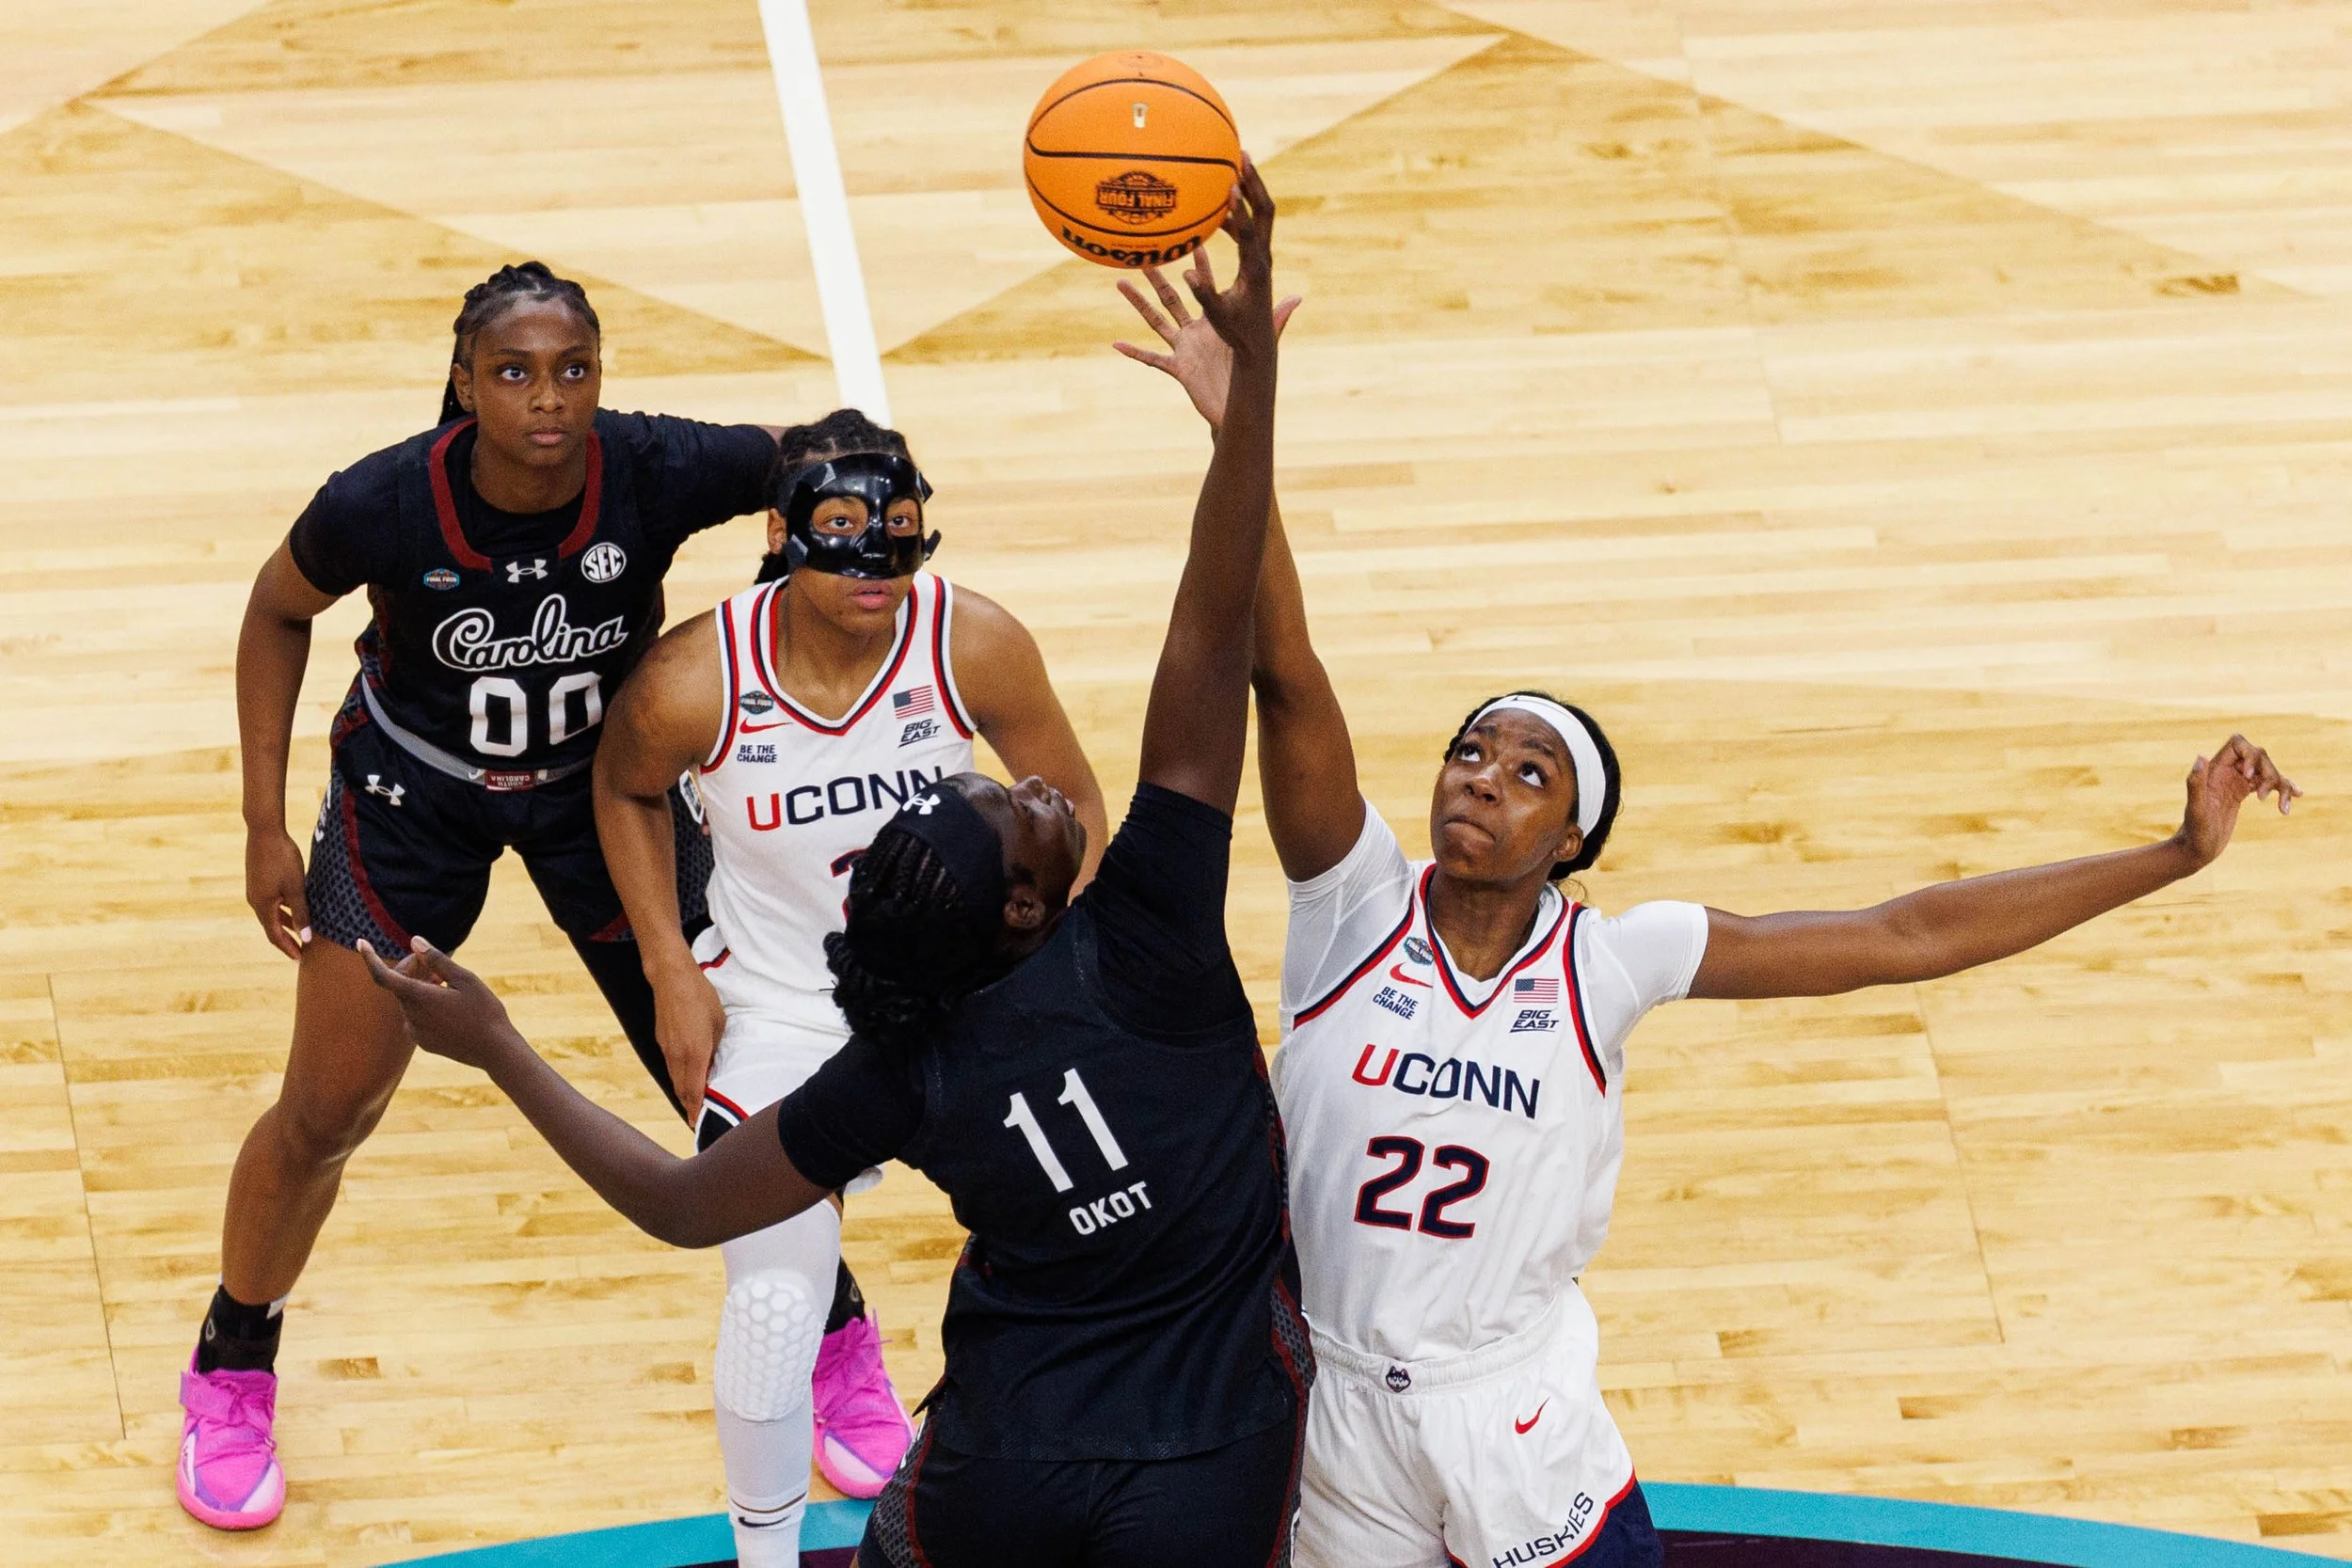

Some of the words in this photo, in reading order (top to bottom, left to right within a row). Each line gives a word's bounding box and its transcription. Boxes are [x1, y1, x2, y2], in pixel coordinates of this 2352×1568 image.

[584, 546, 624, 581] SEC
[432, 594, 628, 672] Carolina
[469, 671, 603, 757] 00
[904, 719, 932, 733] BIG
[739, 744, 753, 753] BE
[756, 744, 775, 753] THE
[901, 724, 941, 742] EAST
[737, 752, 778, 763] CHANGE
[1373, 993, 1416, 1021] CHANGE
[1381, 986, 1398, 1000] BE
[1397, 993, 1419, 1010] THE
[1513, 1019, 1559, 1029] EAST
[1518, 1009, 1550, 1020] BIG
[1351, 1043, 1541, 1120] UCONN
[1003, 1068, 1129, 1193] 11
[1354, 1135, 1490, 1240] 22
[1069, 1180, 1152, 1236] OKOT
[1492, 1491, 1595, 1568] HUSKIES
